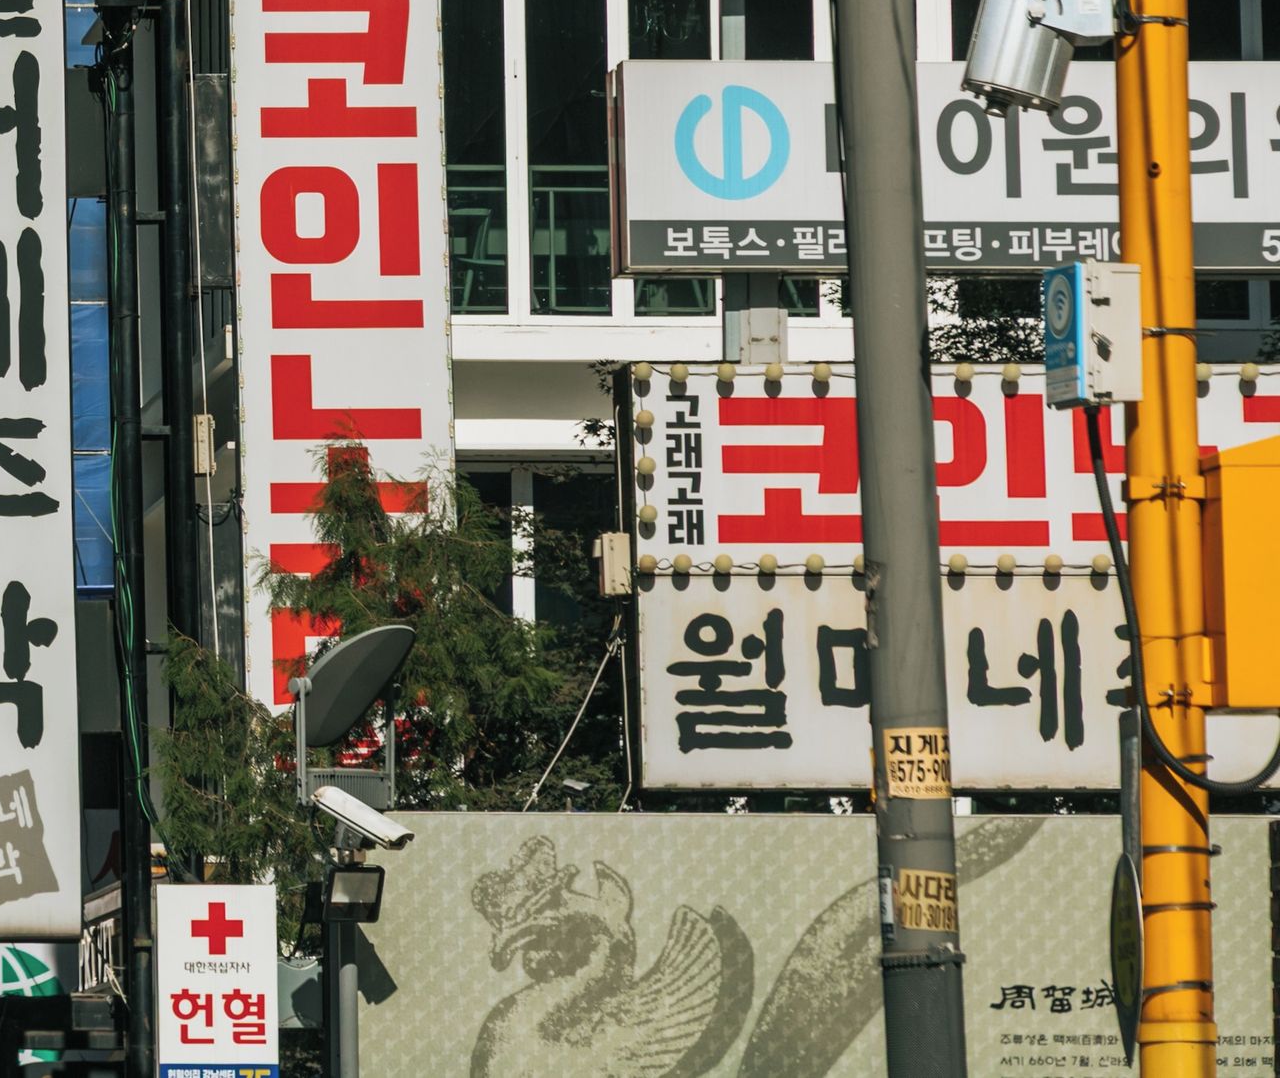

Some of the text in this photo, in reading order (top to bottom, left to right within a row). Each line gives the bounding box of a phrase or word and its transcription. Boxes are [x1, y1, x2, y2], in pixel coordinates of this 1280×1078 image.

[666, 395, 704, 545] 고래고래
[666, 608, 1132, 751] 월네
[184, 961, 251, 974] 대한적십자사
[170, 989, 267, 1044] 헌혈
[1000, 1056, 1024, 1067] 서기
